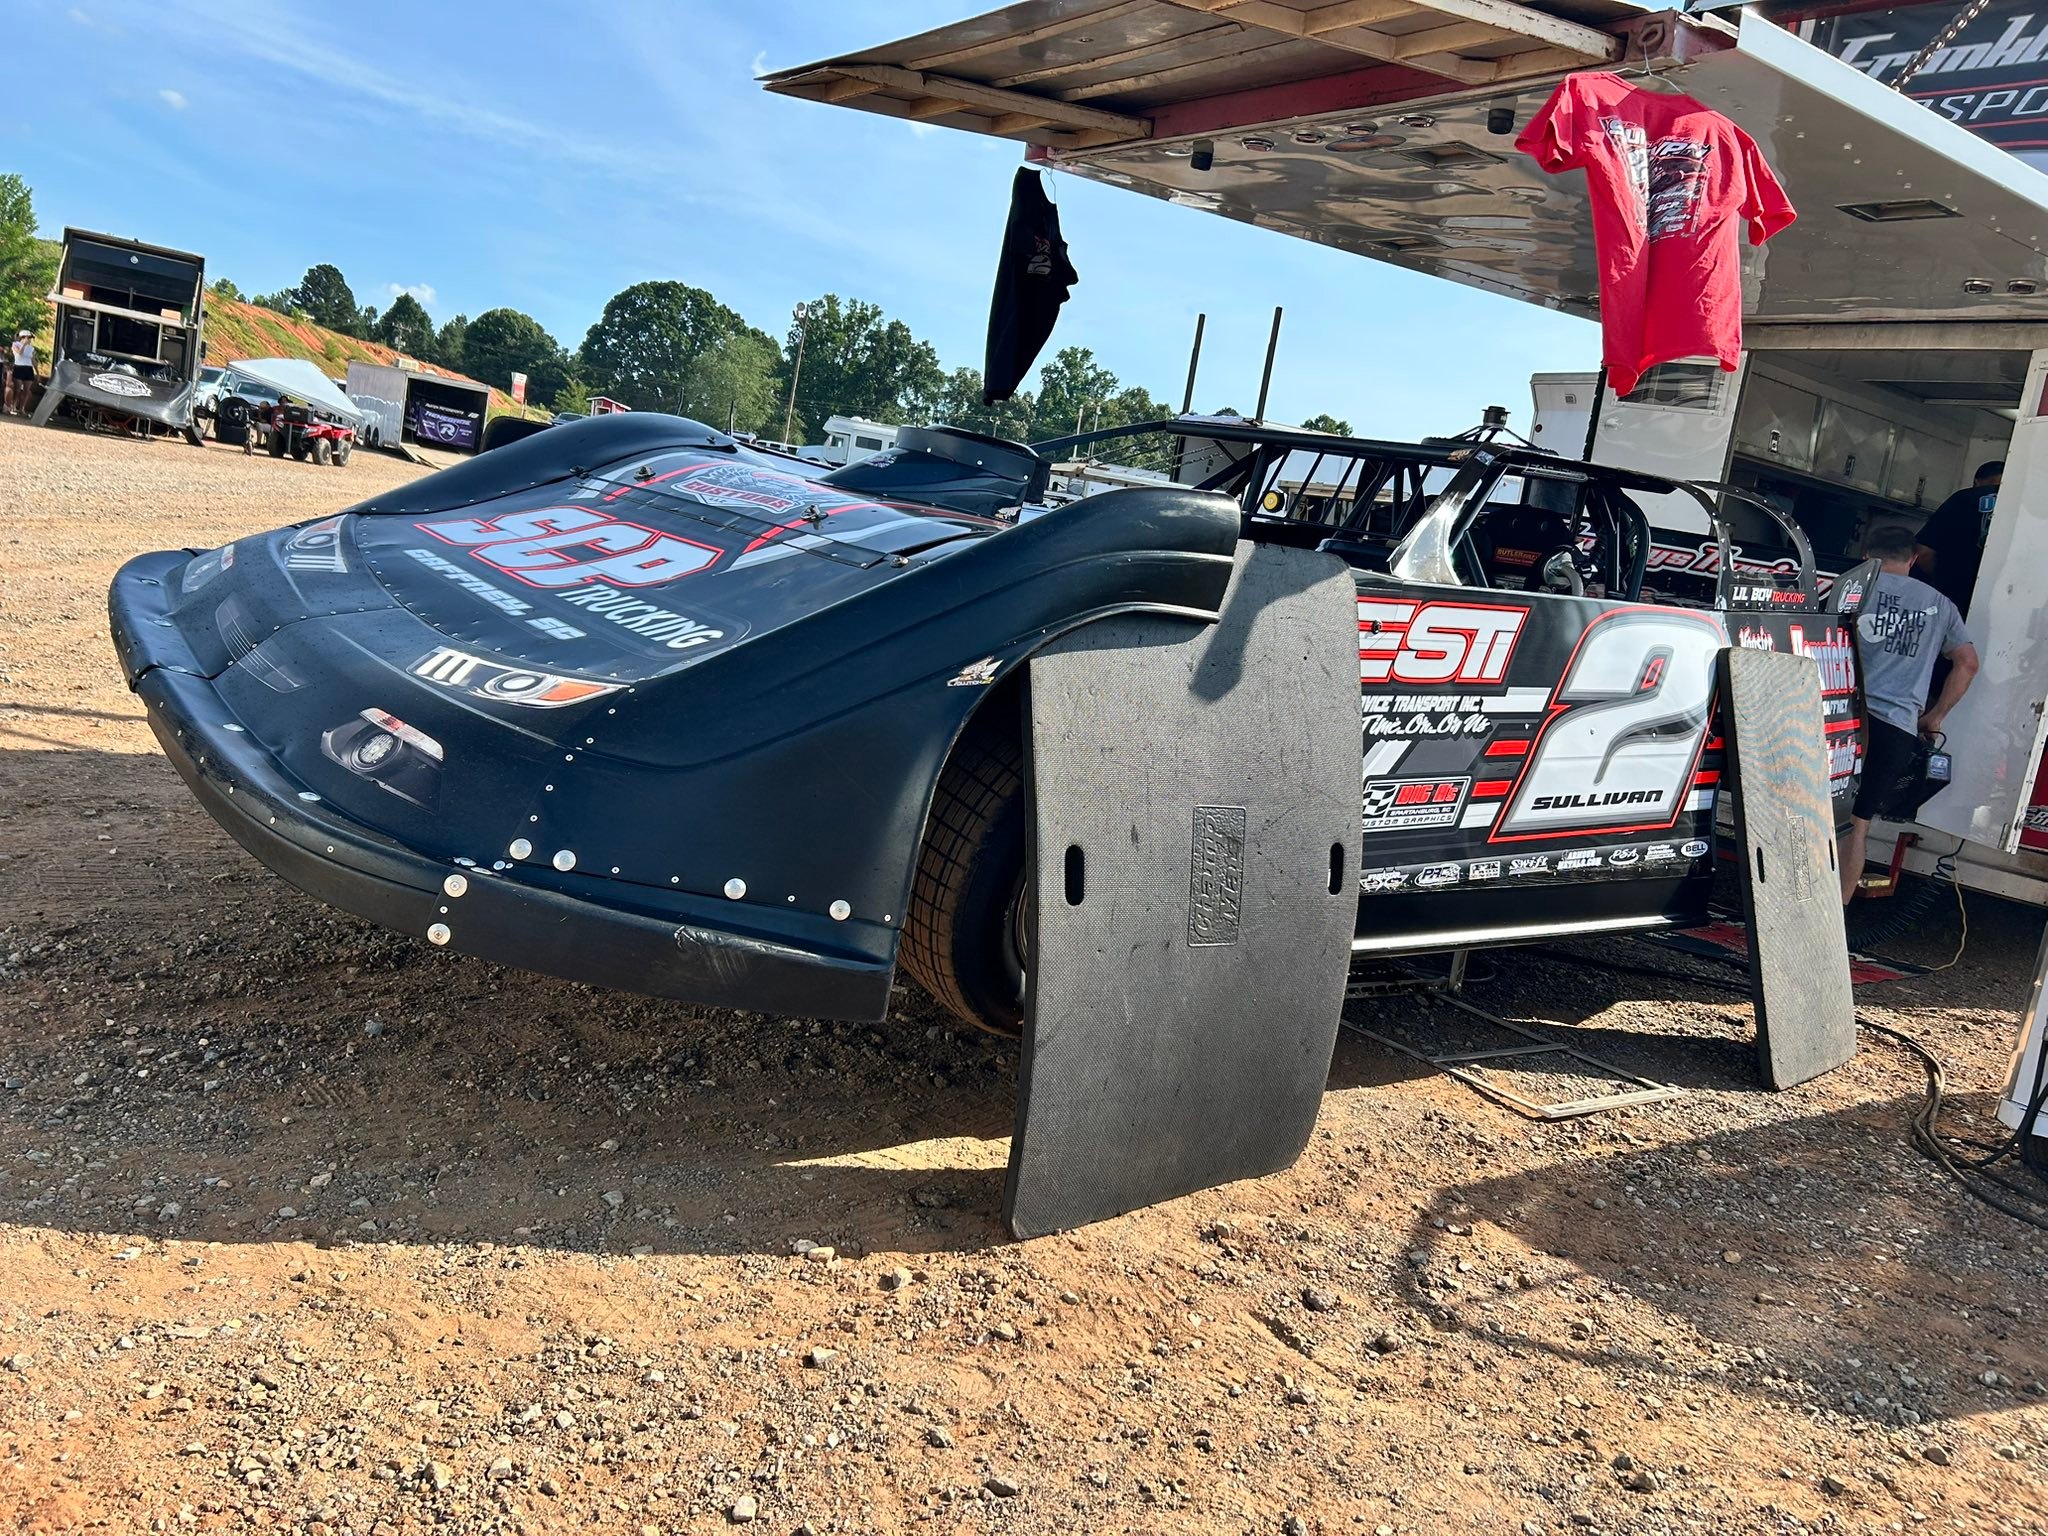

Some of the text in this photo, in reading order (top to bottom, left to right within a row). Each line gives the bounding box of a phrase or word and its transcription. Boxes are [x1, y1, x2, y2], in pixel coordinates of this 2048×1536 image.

[413, 506, 725, 588] SCP
[1732, 586, 1806, 604] LIL BOY TRUCKING
[1877, 590, 1901, 608] THE
[554, 585, 724, 649] TRUCKING
[524, 617, 587, 640] SC
[1392, 695, 1461, 713] TRANSPORT
[1458, 695, 1481, 713] INC
[1497, 609, 1723, 841] 2
[1395, 785, 1434, 805] BIG
[1531, 789, 1664, 811] SULLIVAN
[1362, 814, 1452, 827] USTOM GRAPHICS
[1686, 844, 1706, 852] BELL
[1509, 856, 1548, 870] Swift
